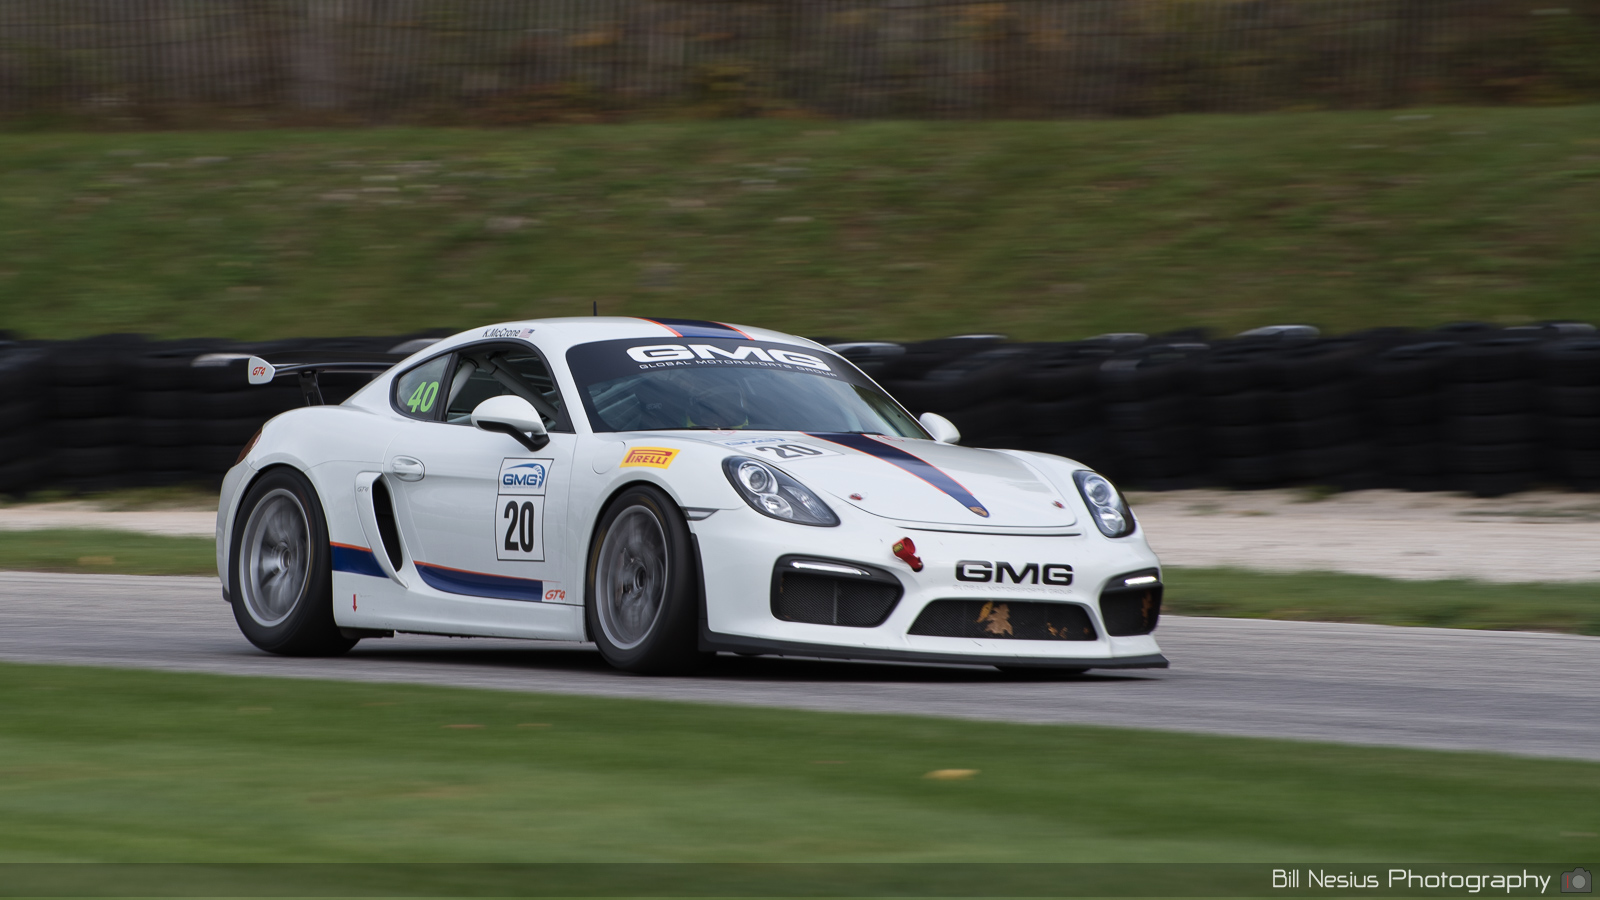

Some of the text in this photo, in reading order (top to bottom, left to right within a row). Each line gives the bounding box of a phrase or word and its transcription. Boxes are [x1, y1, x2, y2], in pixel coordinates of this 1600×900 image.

[626, 344, 832, 372] GMG
[252, 366, 266, 376] GT4
[639, 359, 838, 377] GLOBAL MOTORSPORTS GROUP
[407, 381, 439, 413] 40
[625, 449, 673, 465] PIRELLI
[755, 444, 823, 459] 20
[503, 473, 538, 486] GMG
[504, 500, 534, 553] 20
[955, 559, 1074, 586] GMG
[545, 589, 566, 600] GT4
